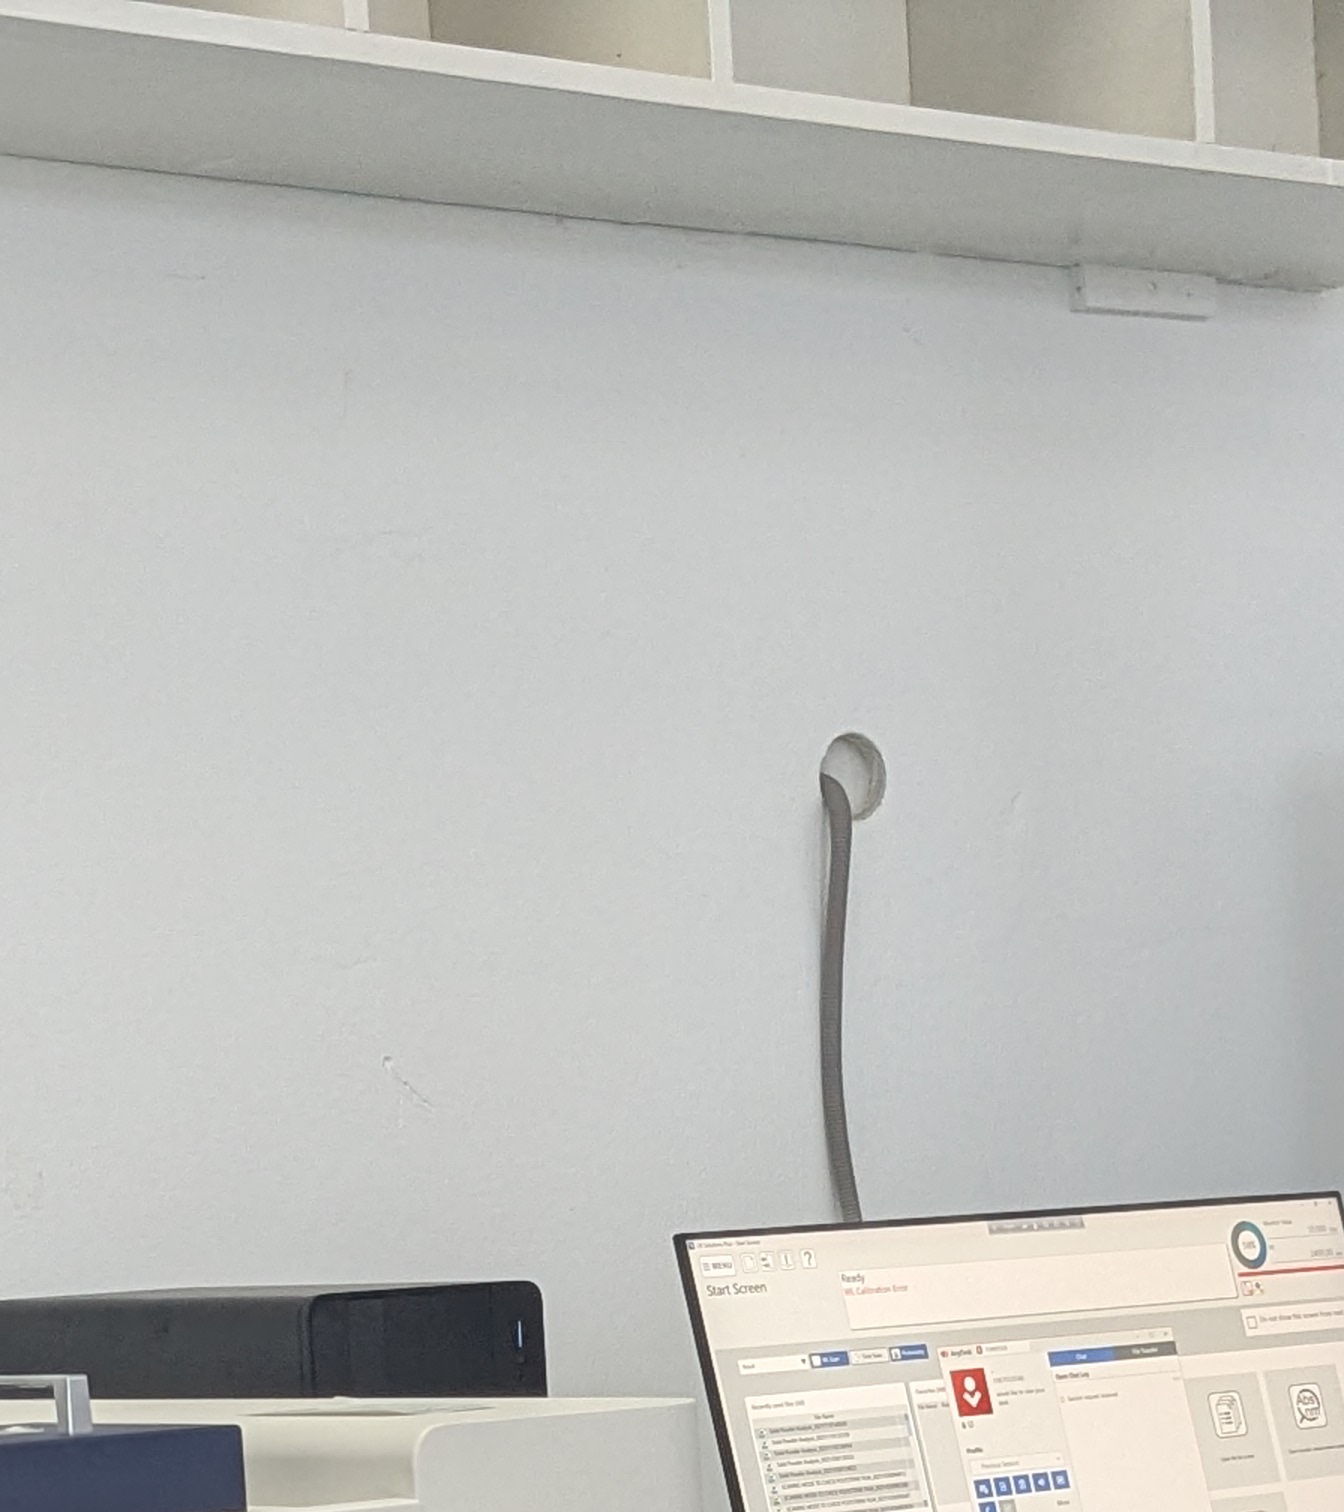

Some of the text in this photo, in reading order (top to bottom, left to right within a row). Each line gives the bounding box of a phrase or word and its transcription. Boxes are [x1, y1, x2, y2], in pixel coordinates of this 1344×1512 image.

[841, 1272, 865, 1286] Ready
[706, 1281, 766, 1297] Start Screen
[1294, 1393, 1314, 1405] Abs
